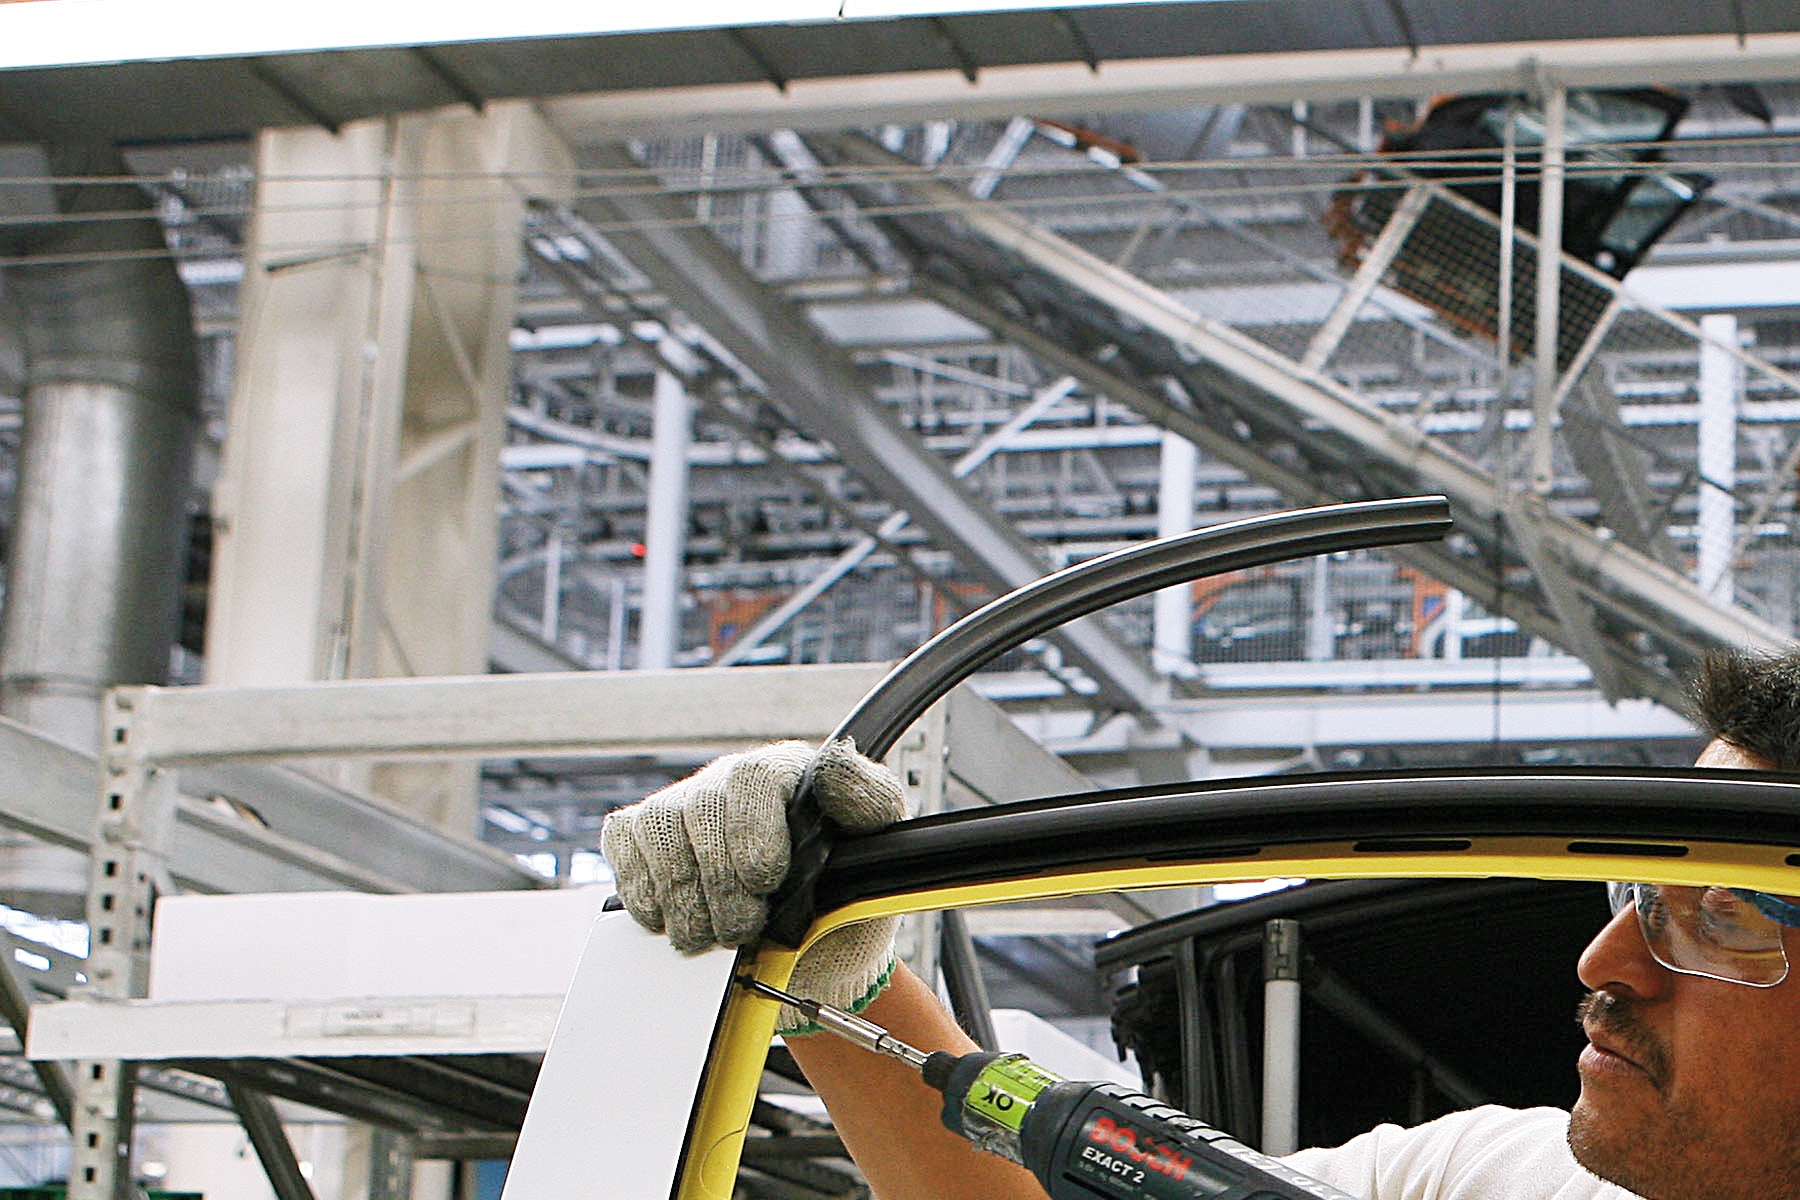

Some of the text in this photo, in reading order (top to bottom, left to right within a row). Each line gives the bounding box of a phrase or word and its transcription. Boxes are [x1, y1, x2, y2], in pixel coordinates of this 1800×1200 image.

[981, 1090, 1014, 1111] OK
[1081, 1146, 1146, 1184] EXACT 2
